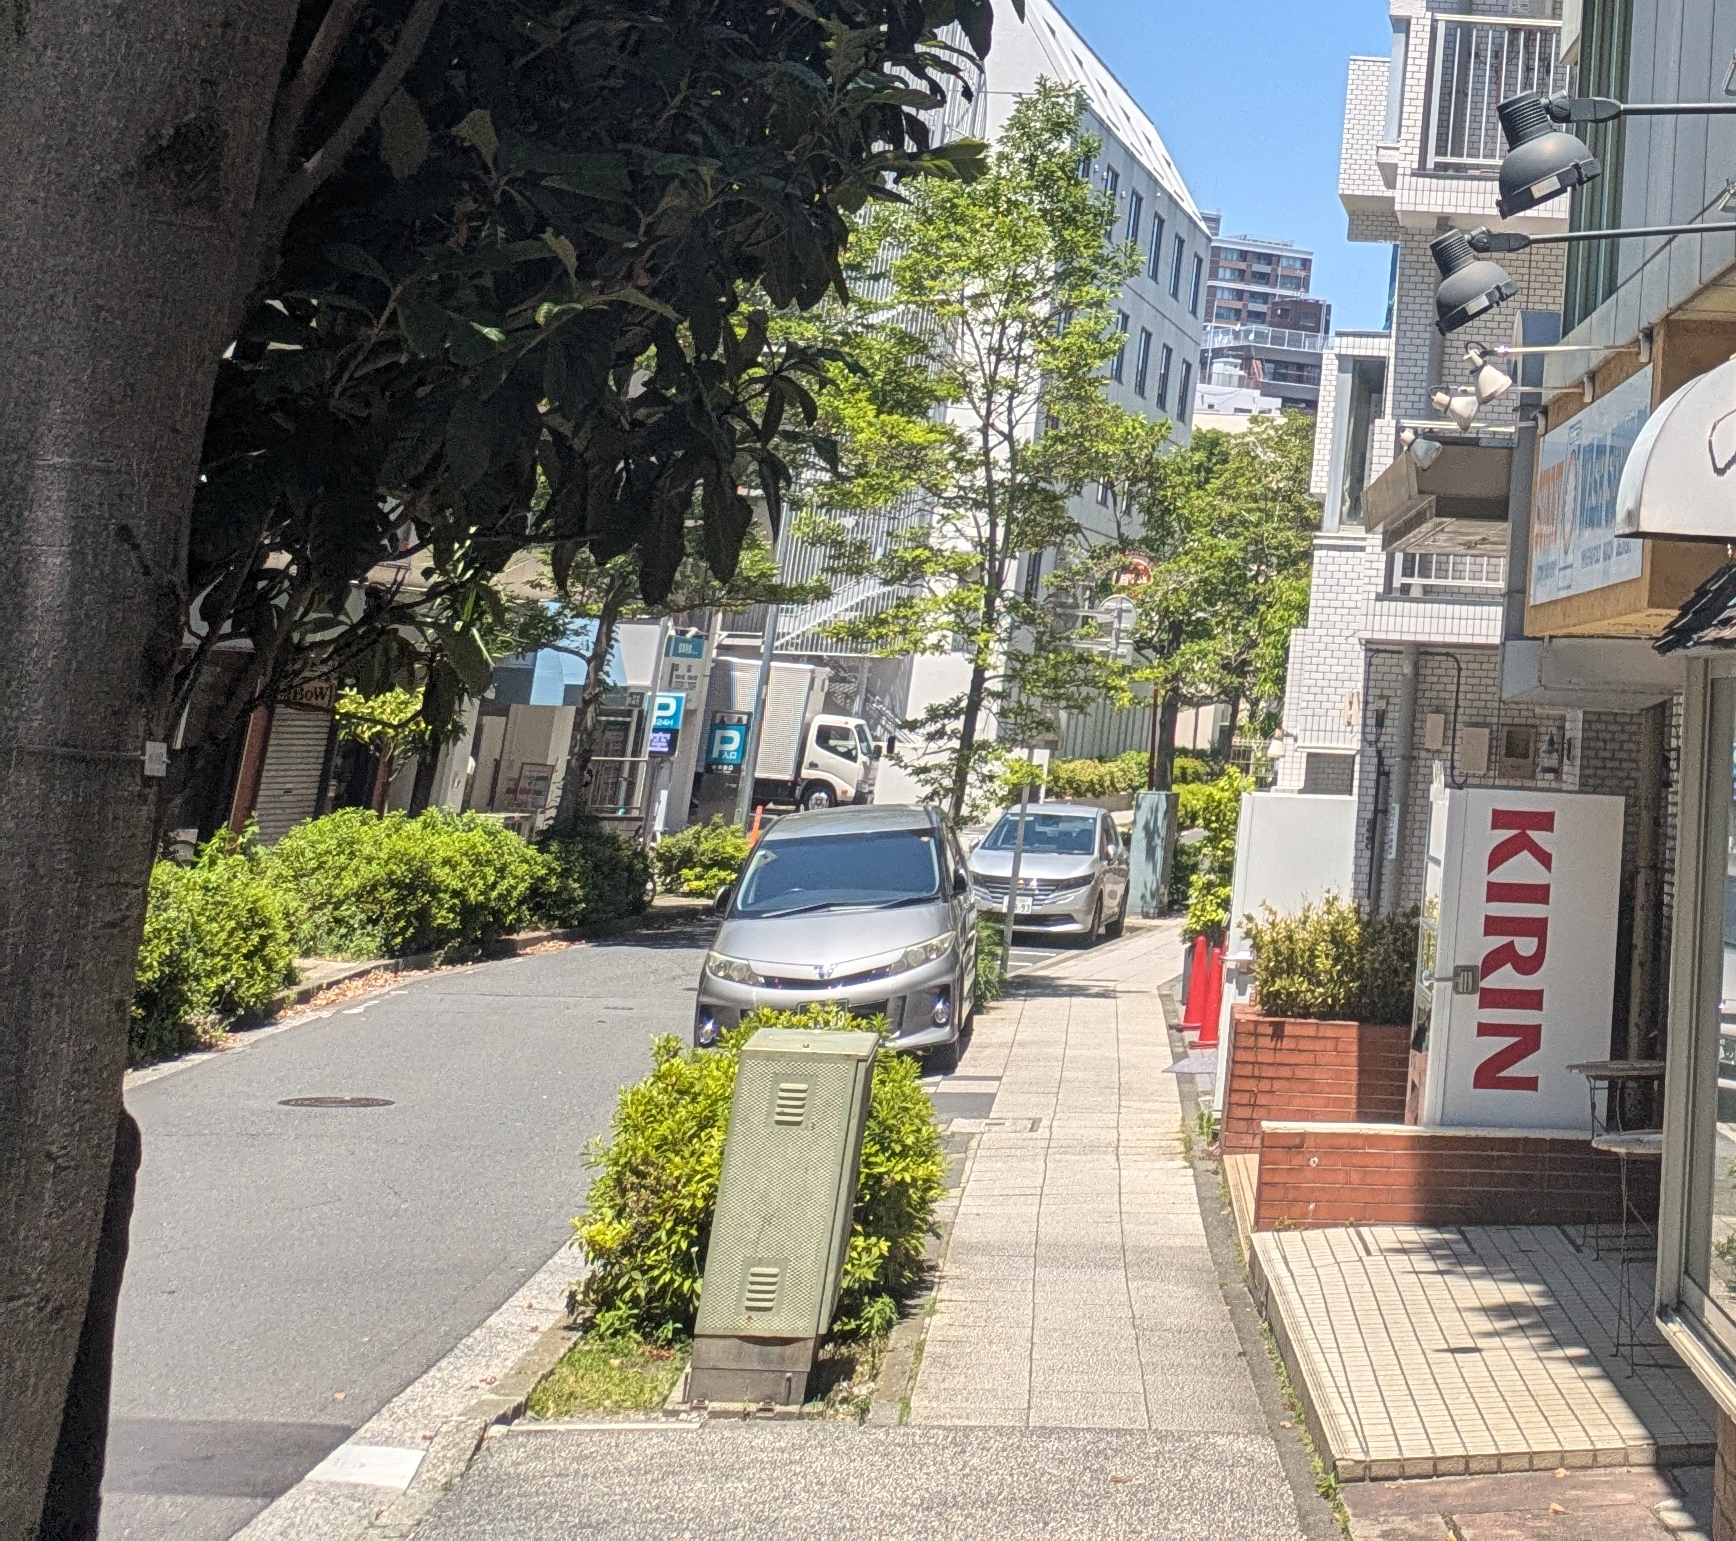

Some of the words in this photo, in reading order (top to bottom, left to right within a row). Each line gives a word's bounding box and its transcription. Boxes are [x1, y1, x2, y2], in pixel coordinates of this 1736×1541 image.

[652, 696, 677, 725] P
[656, 718, 673, 726] 24H
[648, 731, 671, 752] 空
[712, 729, 740, 758] P
[1473, 808, 1556, 1092] KIRIN
